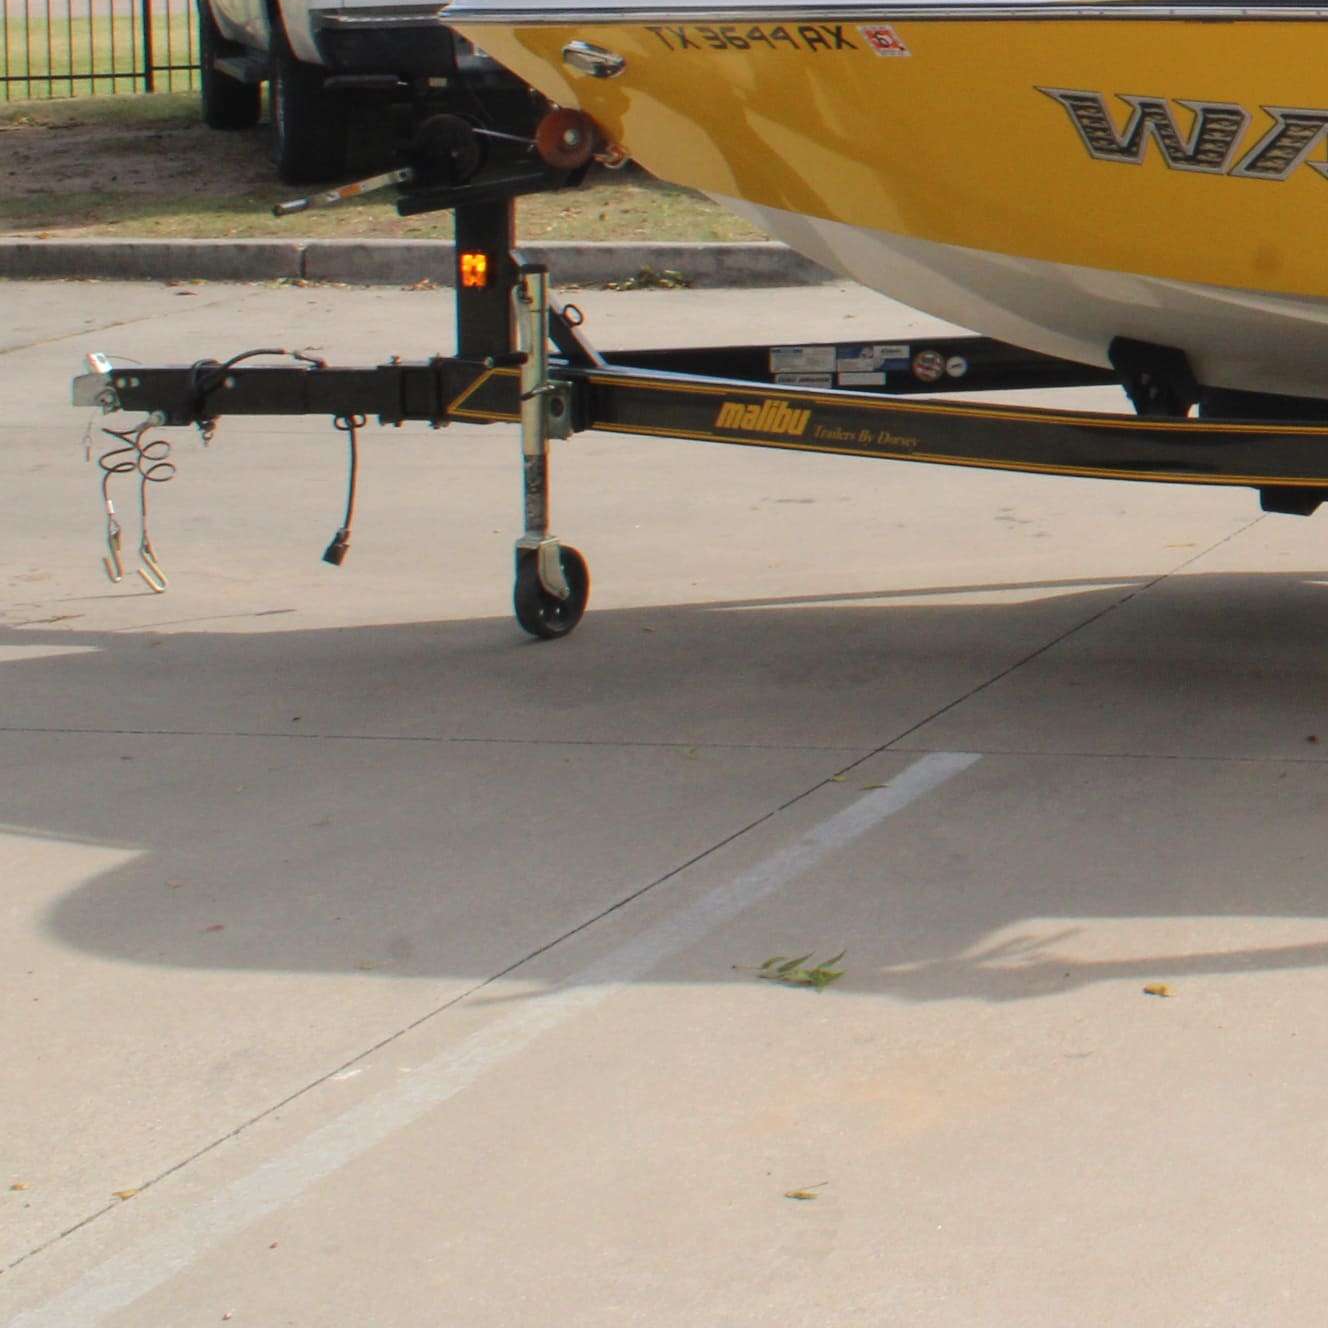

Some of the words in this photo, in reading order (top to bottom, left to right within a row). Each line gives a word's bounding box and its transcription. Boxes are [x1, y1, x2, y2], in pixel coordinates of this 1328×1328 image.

[645, 25, 700, 51] TX
[798, 24, 859, 52] AX
[716, 398, 812, 436] malibu
